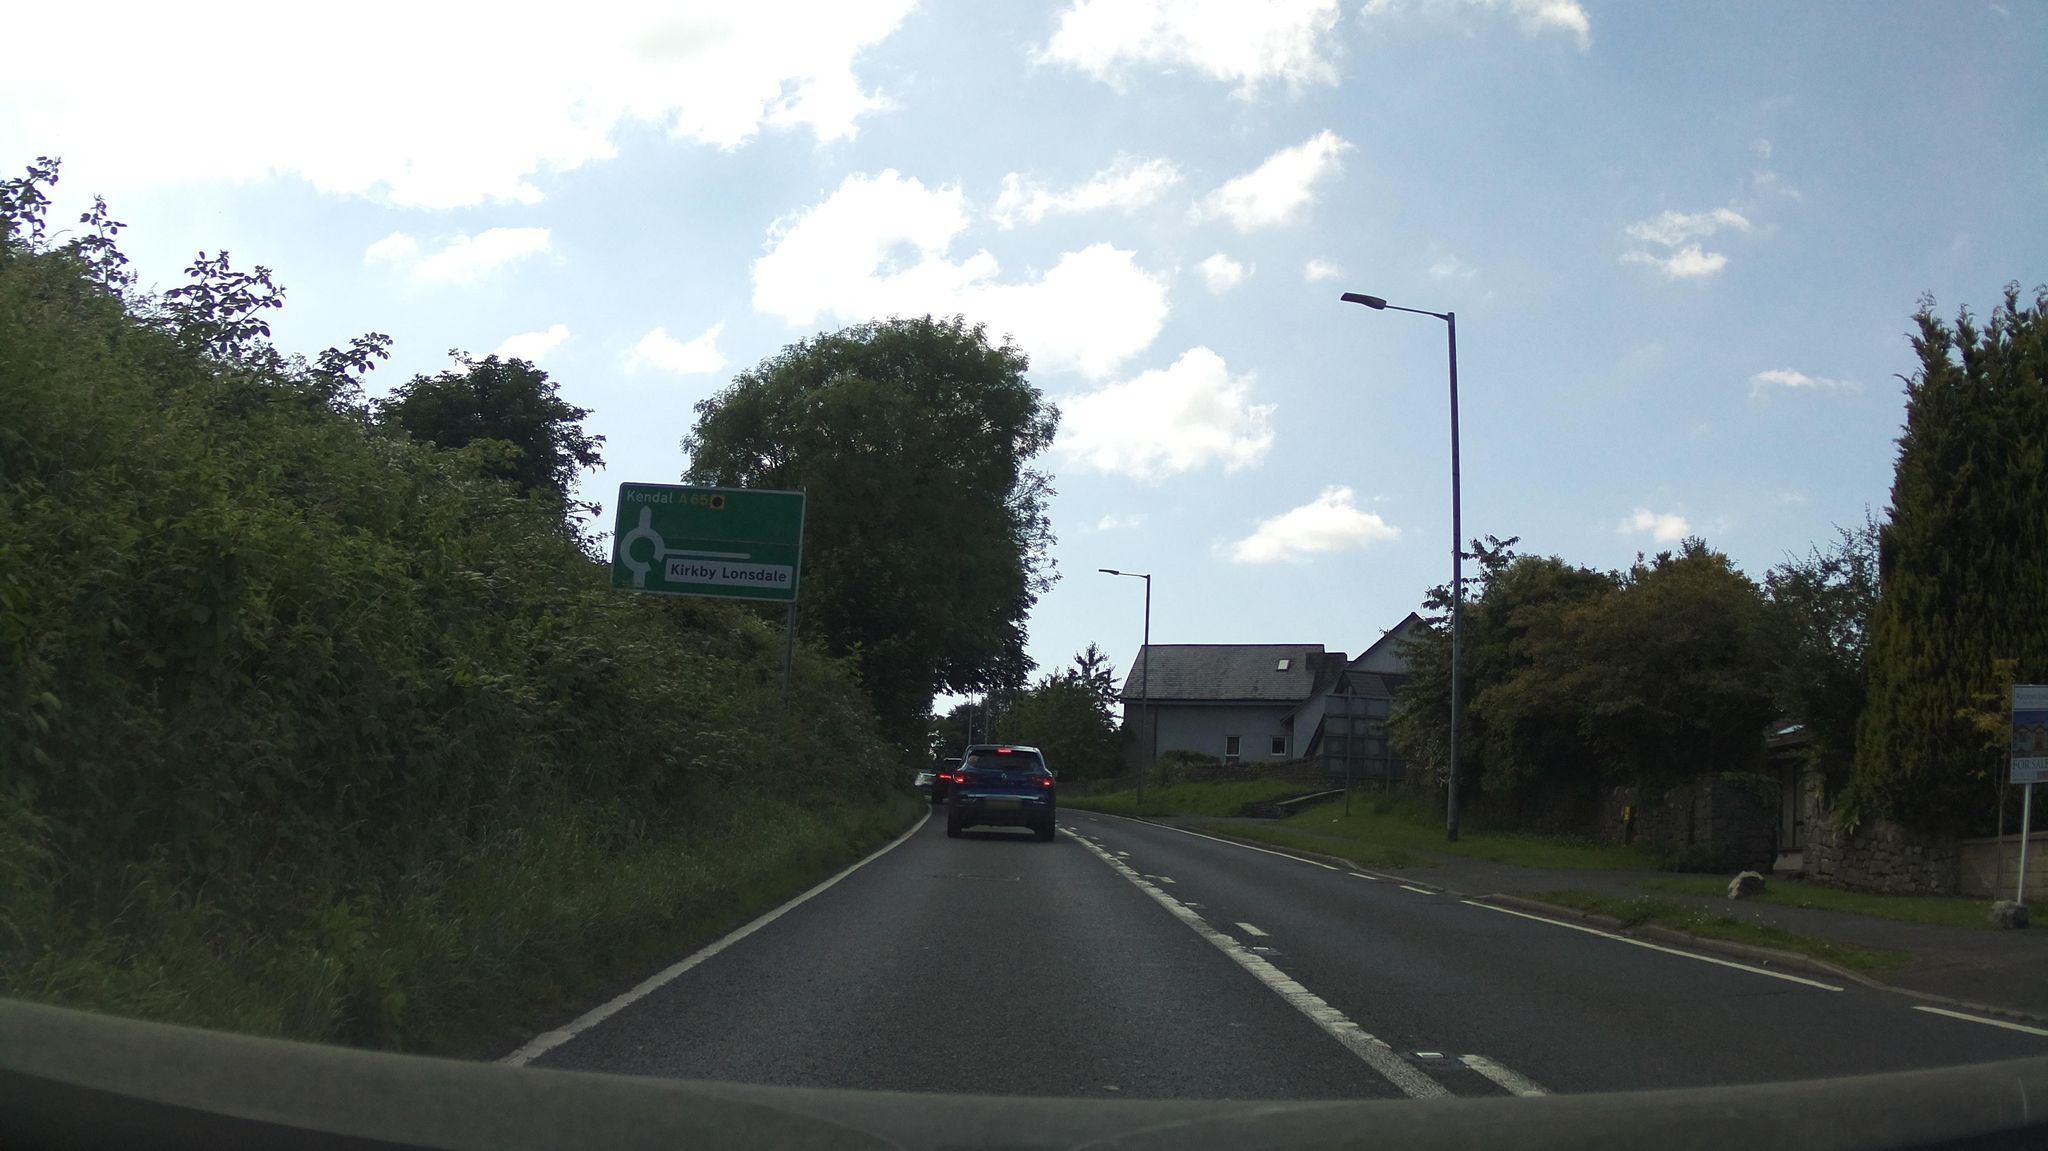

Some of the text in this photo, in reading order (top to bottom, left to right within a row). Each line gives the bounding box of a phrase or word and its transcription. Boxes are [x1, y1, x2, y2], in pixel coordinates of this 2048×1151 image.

[627, 490, 709, 505] Kendal A65
[670, 564, 787, 582] Kirkby Lonsdale
[2012, 759, 2030, 769] FOR
